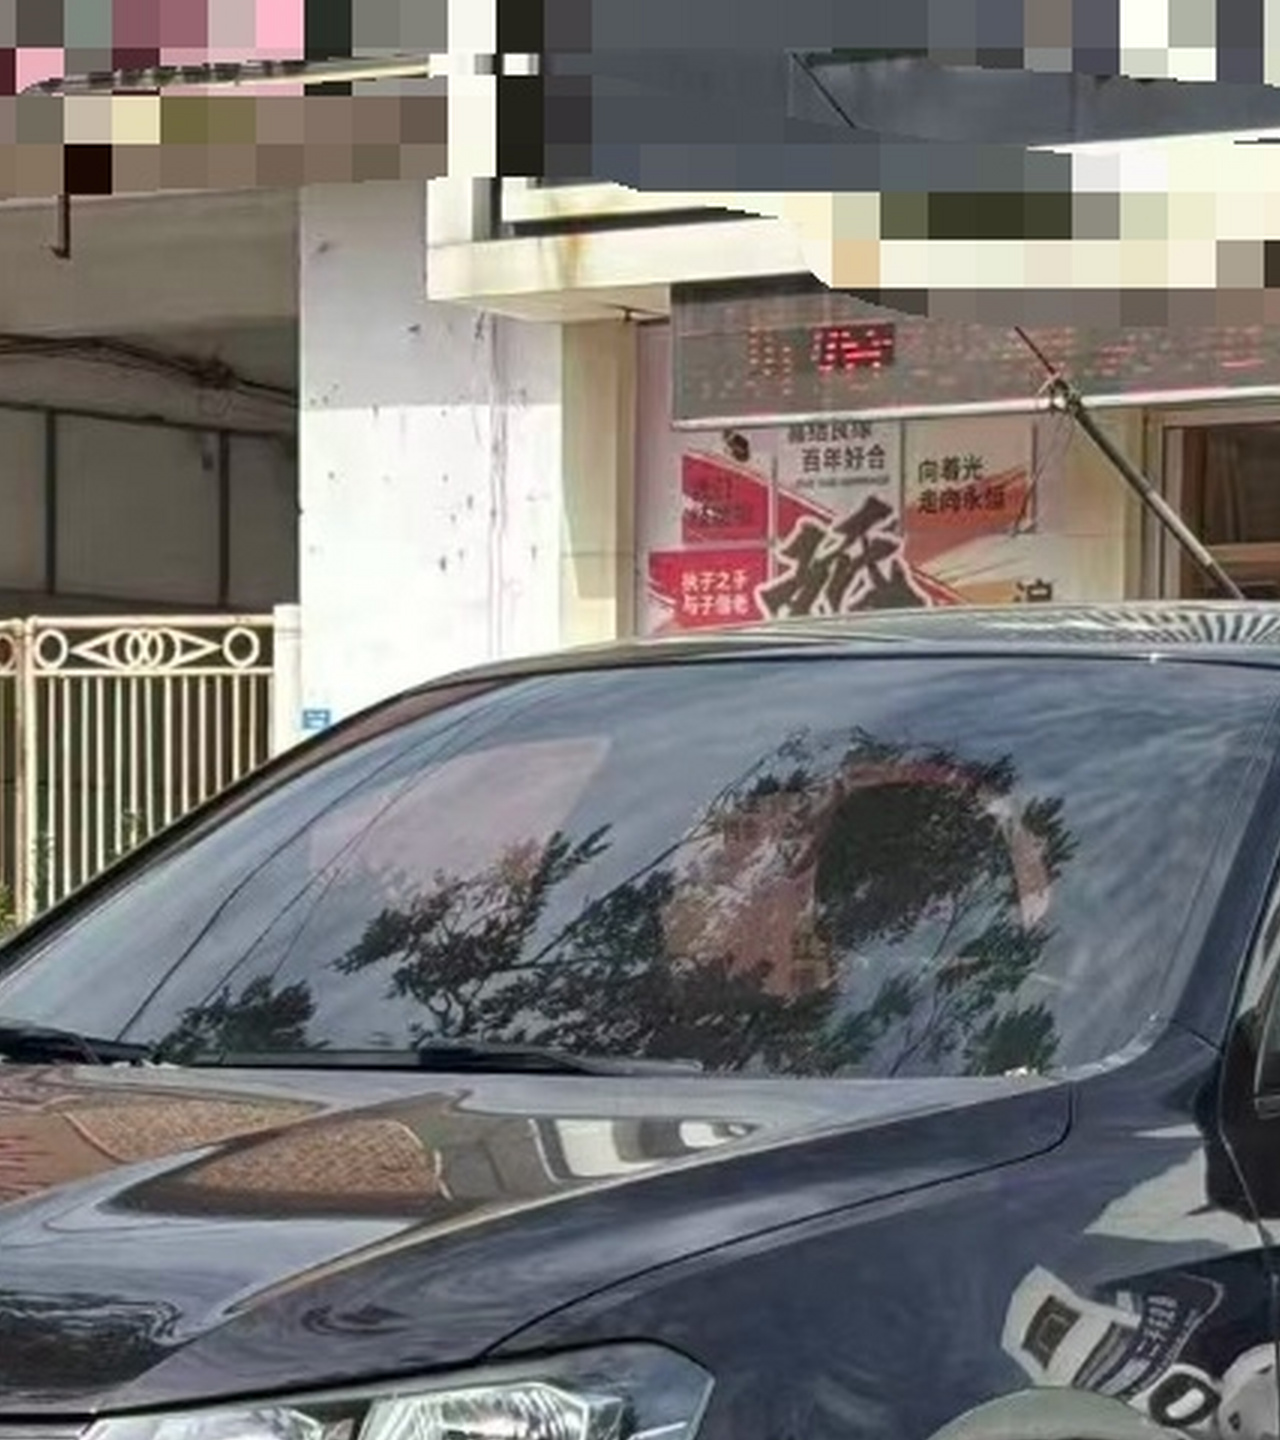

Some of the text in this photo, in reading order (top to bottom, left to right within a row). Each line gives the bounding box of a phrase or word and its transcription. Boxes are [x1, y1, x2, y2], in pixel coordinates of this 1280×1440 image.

[801, 444, 886, 473] 百年好合
[918, 455, 983, 483] 向着光
[918, 486, 1006, 514] 走向永恒
